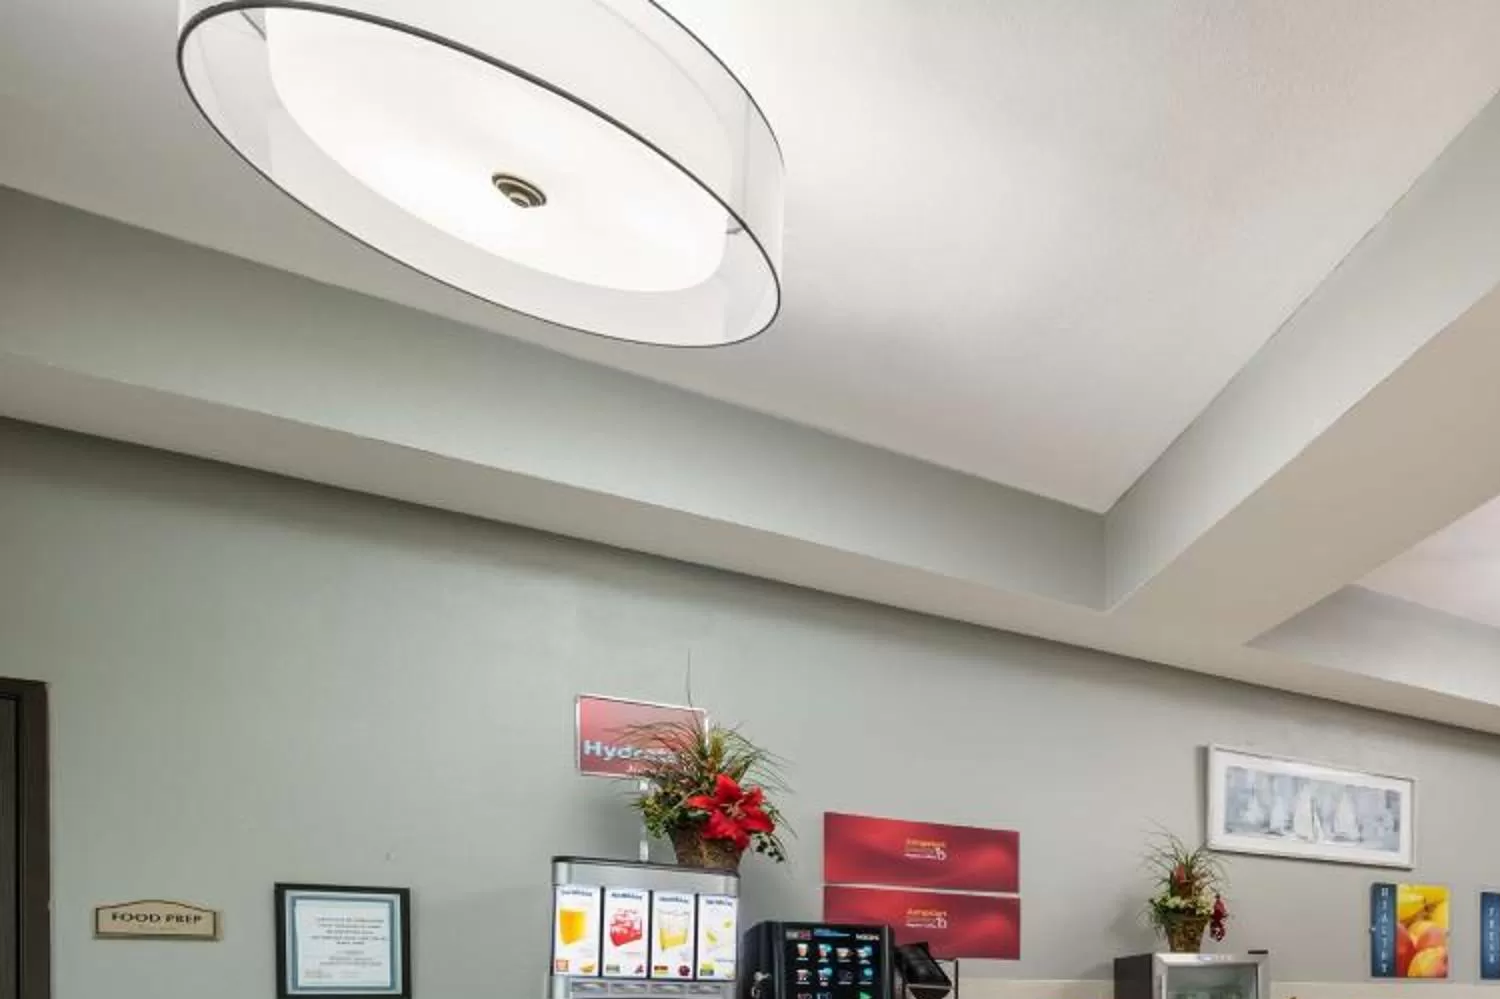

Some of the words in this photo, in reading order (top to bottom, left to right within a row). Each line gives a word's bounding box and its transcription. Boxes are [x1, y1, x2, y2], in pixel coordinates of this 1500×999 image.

[583, 740, 685, 763] Hydr
[112, 912, 160, 922] FOOD
[165, 913, 203, 924] PREP
